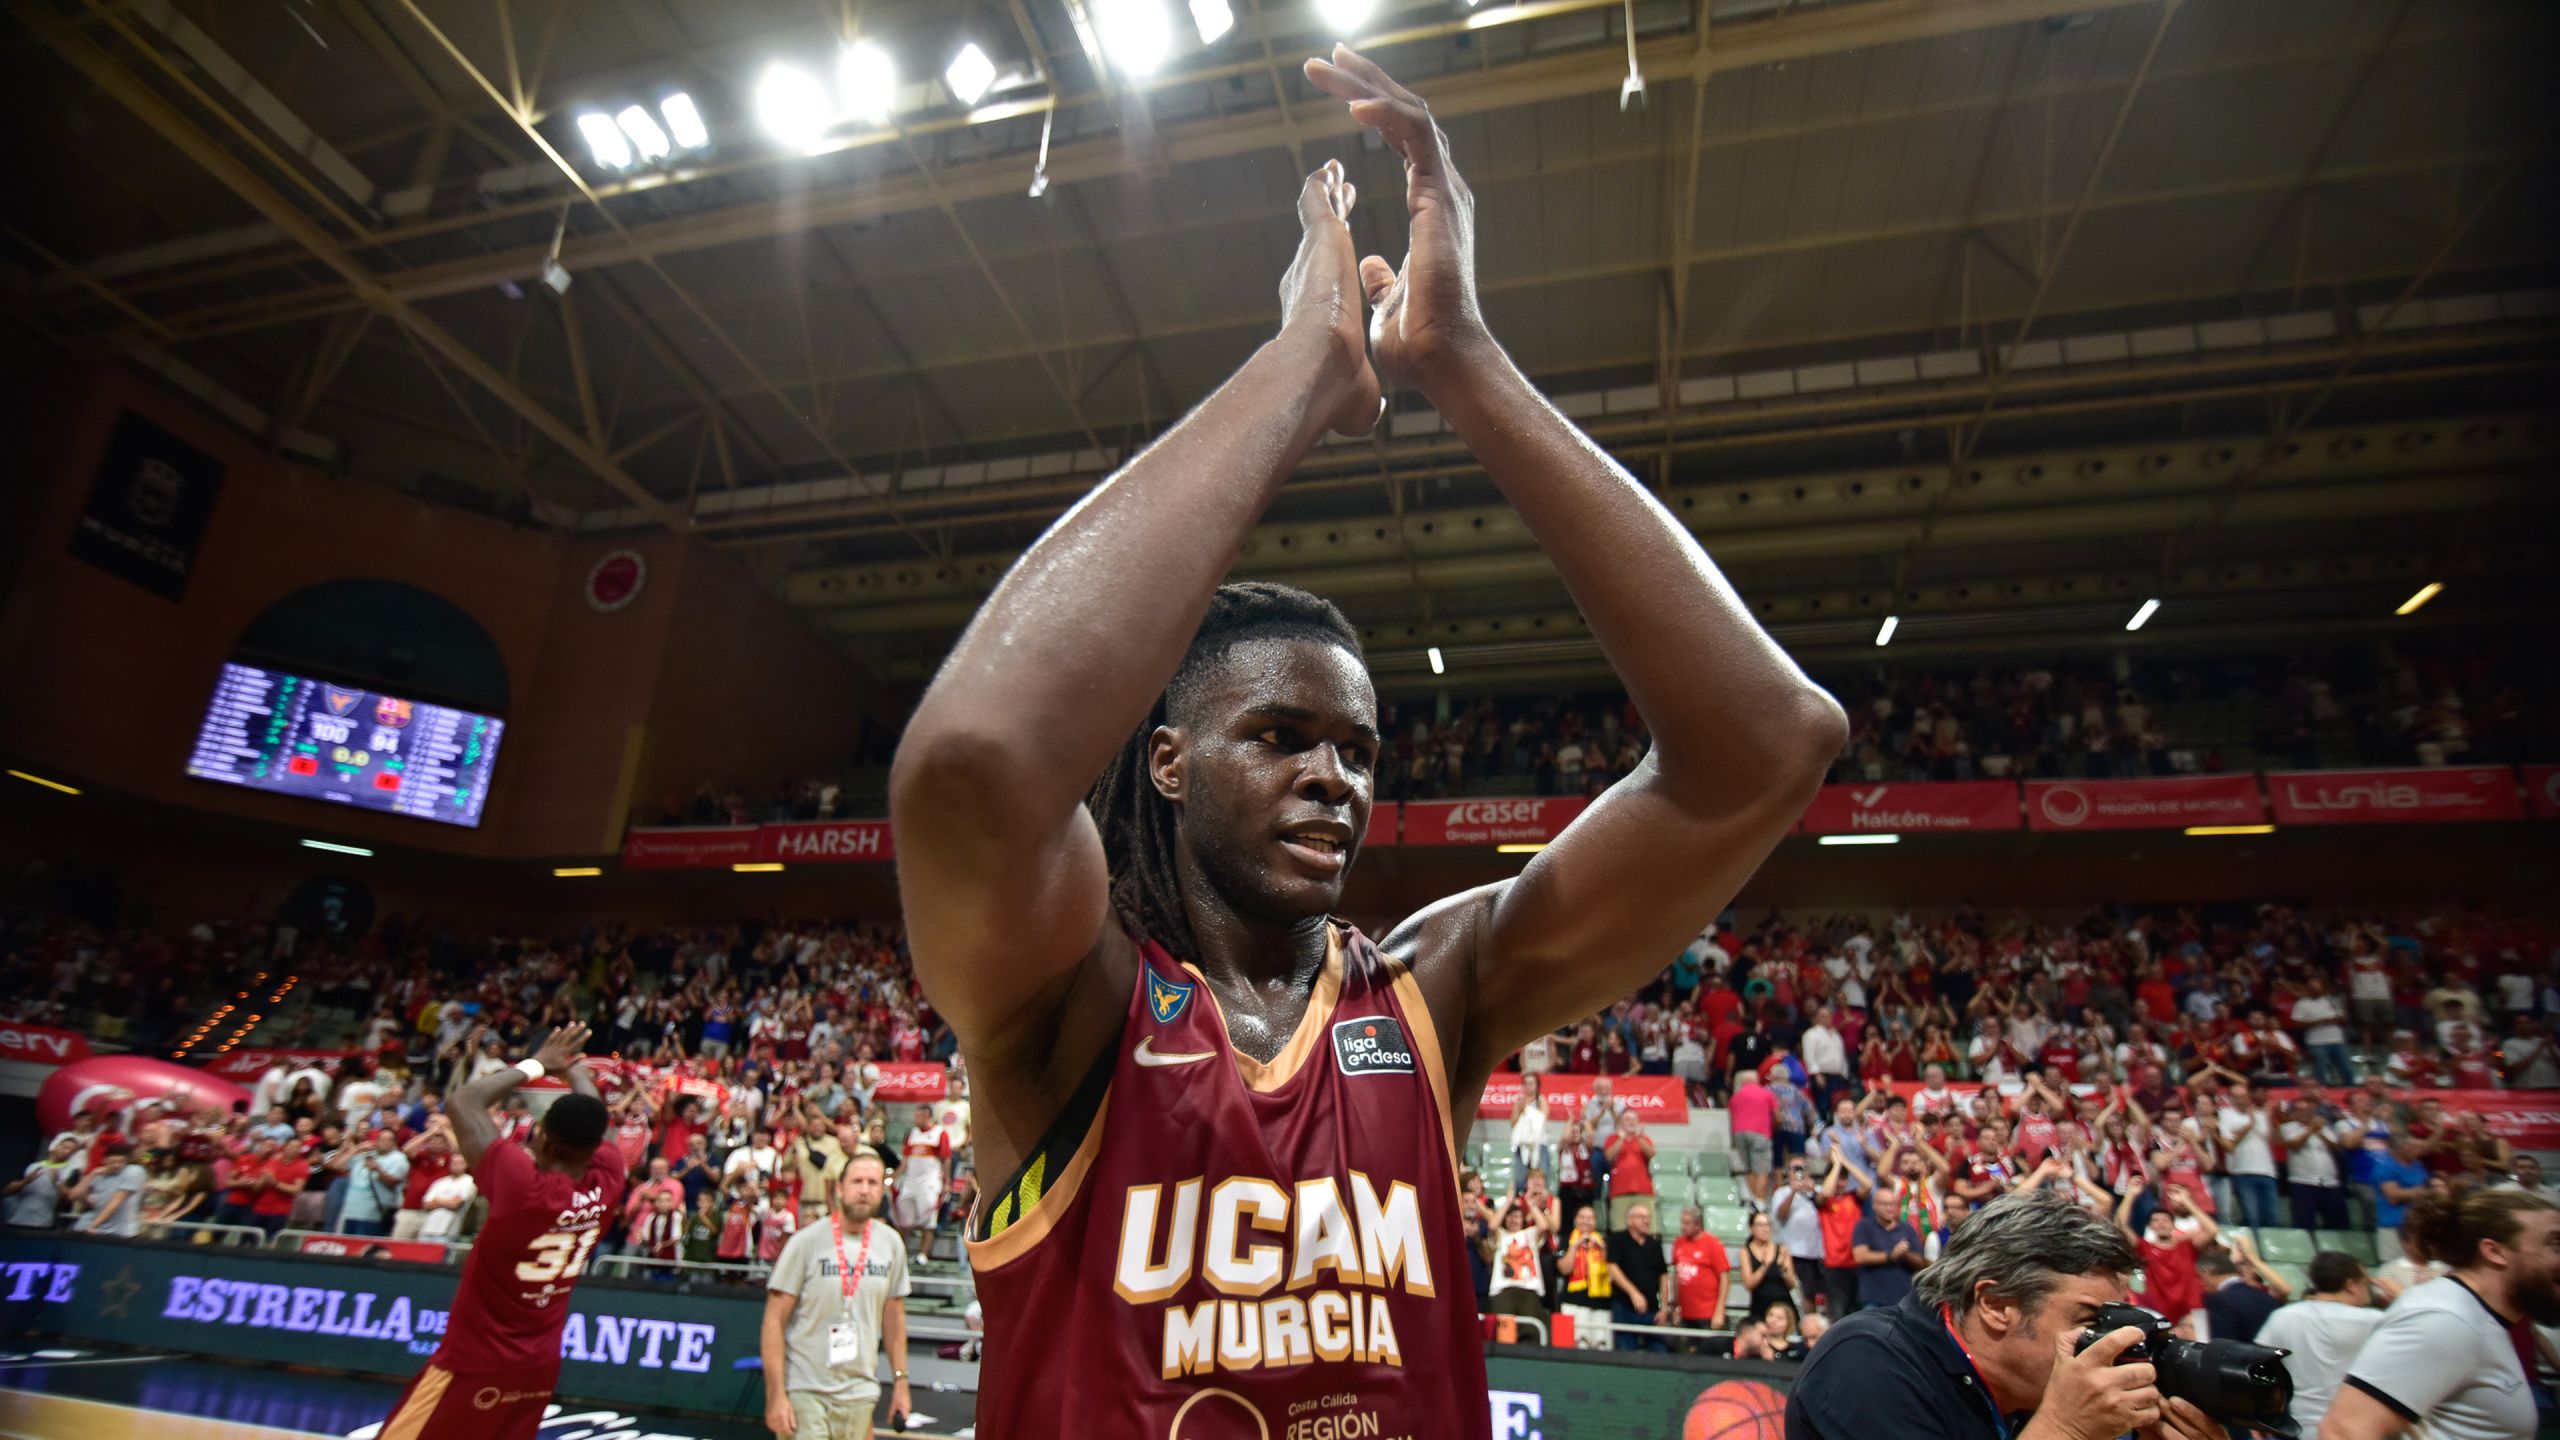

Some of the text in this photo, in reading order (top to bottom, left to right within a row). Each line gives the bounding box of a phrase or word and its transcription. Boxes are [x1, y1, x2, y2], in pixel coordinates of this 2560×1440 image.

[1465, 799, 1545, 824] caser
[1851, 808, 1931, 828] Halcón
[777, 829, 880, 855] MARSH
[1445, 828, 1488, 843] Grupo
[1342, 1036, 1377, 1053] liga
[1347, 1049, 1412, 1066] endesa
[1548, 1092, 1576, 1106] DE
[1113, 1169, 1436, 1305] UCAM
[515, 1227, 601, 1281] 31
[162, 1275, 716, 1373] ESTRELLA DE ANTE
[1161, 1290, 1402, 1381] MURCIA
[1288, 1392, 1358, 1417] Costa Cálida
[1287, 1409, 1380, 1440] REGIÓN
